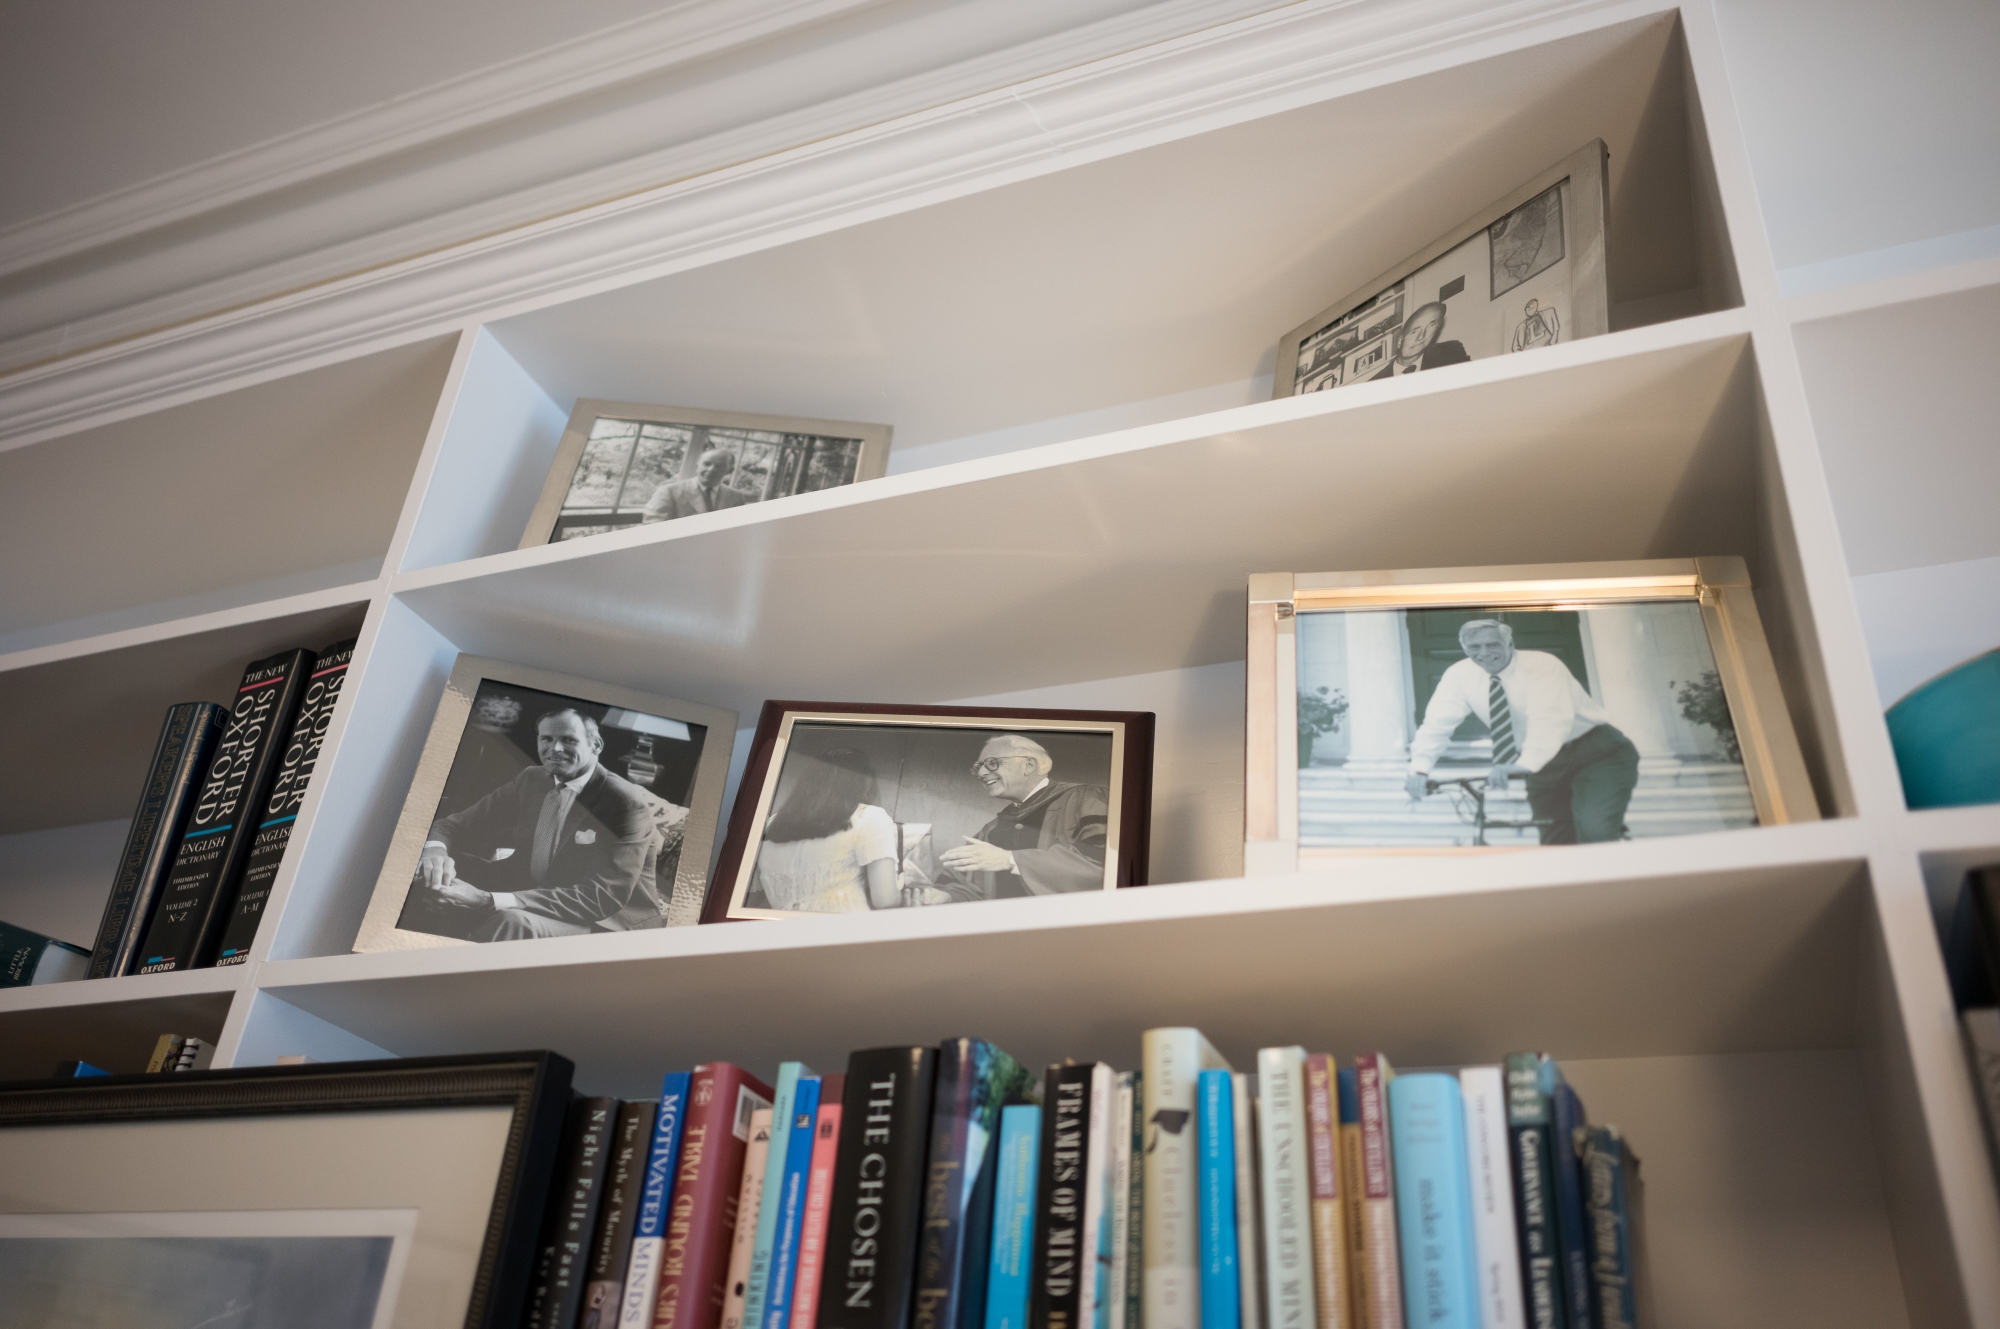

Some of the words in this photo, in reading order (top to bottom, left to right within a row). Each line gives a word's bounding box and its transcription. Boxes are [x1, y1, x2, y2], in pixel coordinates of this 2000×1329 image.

[245, 670, 265, 684] THE
[264, 663, 287, 679] NEW
[316, 656, 334, 670] THE
[150, 704, 194, 799] SPEAKER'S
[195, 695, 255, 825] OXFORD
[216, 688, 276, 821] SHORTER
[268, 682, 325, 815] OXFORD
[287, 674, 346, 810] SHORTER
[117, 799, 162, 894] LIFETIME
[176, 850, 220, 867] DICTIONARY
[179, 835, 226, 856] ENGLISH
[250, 841, 288, 857] DICTIONAR
[173, 876, 194, 885] THUMB
[193, 872, 210, 882] INDEX
[177, 881, 200, 891] EDITION
[240, 890, 266, 902] VOLUME
[250, 871, 271, 882] EDITION
[165, 900, 193, 912] VOLUME
[168, 911, 188, 924] N-Z
[240, 902, 260, 915] A-M
[90, 896, 130, 979] LIBRAR
[216, 954, 249, 968] OXFORD
[13, 946, 32, 981] BROWN
[140, 961, 176, 975] OXFORD
[863, 1072, 896, 1147] THE
[1271, 1071, 1291, 1113] THE
[582, 1110, 607, 1167] Night
[626, 1117, 640, 1143] The
[1052, 1082, 1084, 1183] FRAMES
[615, 1147, 634, 1184] Myth
[641, 1093, 680, 1236] MOTIVATED
[568, 1176, 594, 1231] Falls
[611, 1188, 623, 1205] of
[664, 1194, 694, 1276] ROUND
[681, 1123, 708, 1182] TABLE
[925, 1160, 960, 1229] best
[1049, 1187, 1078, 1221] OF
[1162, 1145, 1184, 1264] Clueless
[1273, 1121, 1298, 1270] UNSCHOOLED
[1418, 1178, 1442, 1239] make
[595, 1208, 622, 1275] Maturity
[845, 1152, 887, 1310] CHOSEN
[1424, 1243, 1442, 1262] it
[556, 1242, 581, 1287] Fast
[624, 1241, 653, 1324] MINDS
[1044, 1226, 1076, 1297] MIND
[1163, 1277, 1181, 1307] in
[1281, 1278, 1302, 1329] MIN
[1427, 1268, 1450, 1324] stick
